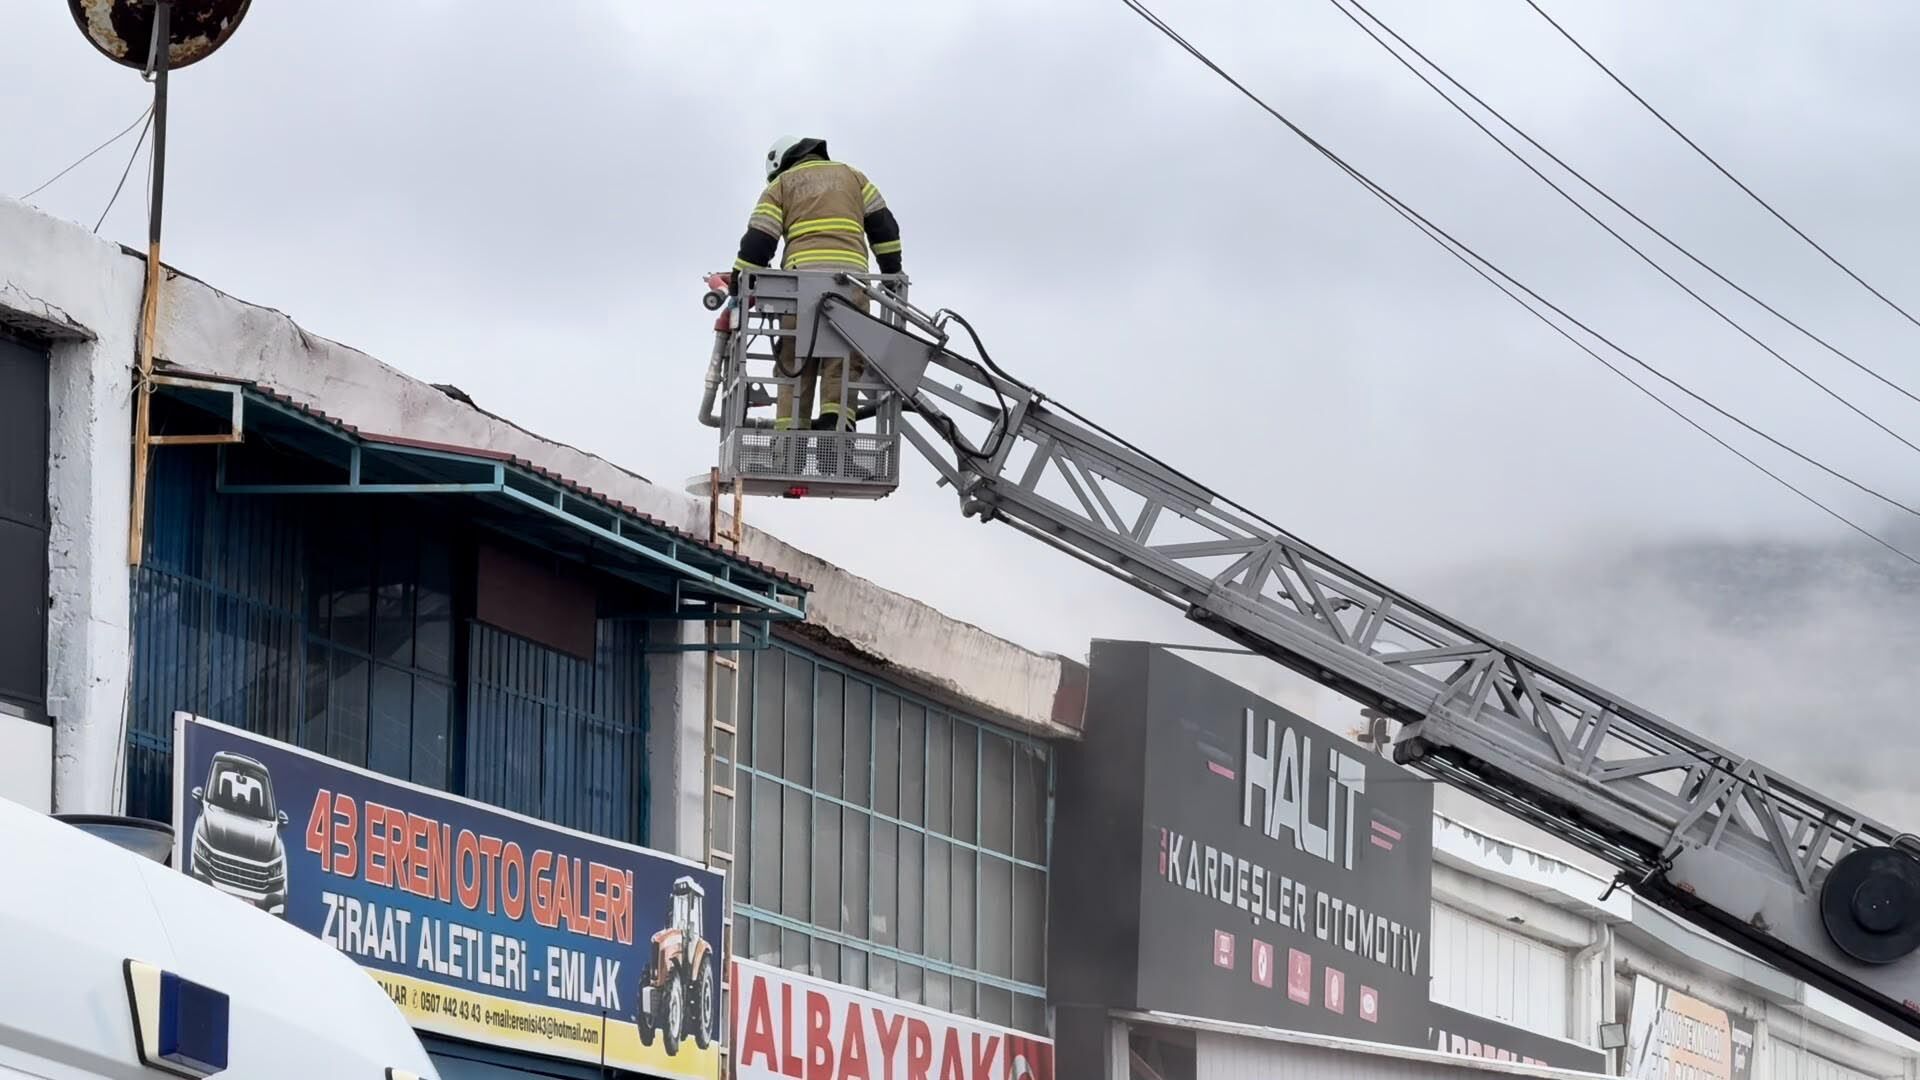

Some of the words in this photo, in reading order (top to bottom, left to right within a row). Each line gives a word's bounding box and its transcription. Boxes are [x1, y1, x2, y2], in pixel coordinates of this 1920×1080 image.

[305, 788, 358, 878] 43
[364, 800, 452, 904] EREN
[455, 828, 526, 921] OTO
[1168, 831, 1307, 933] KARDEŞLER
[420, 990, 441, 1014] 0507
[442, 996, 458, 1019] 442
[459, 1000, 469, 1021] 43
[470, 1003, 481, 1024] 43
[546, 945, 621, 1011] EMLAK
[740, 974, 1001, 1080] ALBAYRAK
